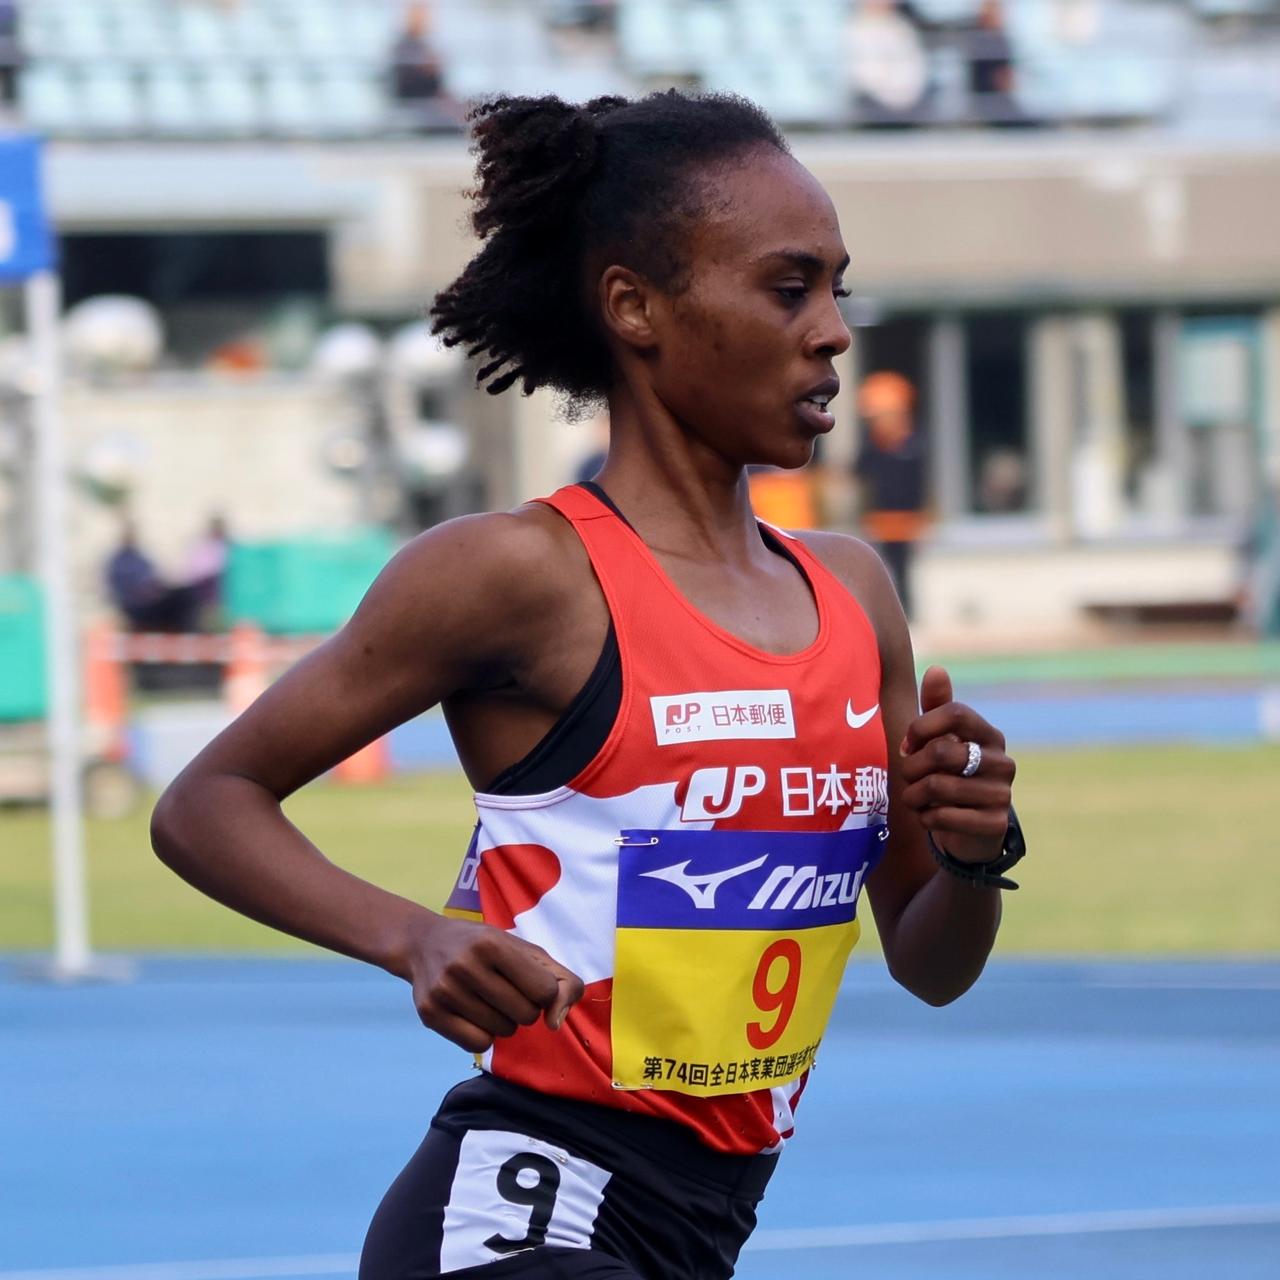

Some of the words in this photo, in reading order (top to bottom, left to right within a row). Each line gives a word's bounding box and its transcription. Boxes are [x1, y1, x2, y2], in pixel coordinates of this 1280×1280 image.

[665, 724, 702, 735] POST
[666, 702, 701, 727] JP
[712, 703, 786, 727] 日本郵便
[681, 765, 766, 821] JP
[780, 764, 888, 816] 日本郵
[746, 938, 802, 1050] 9
[483, 1152, 561, 1255] 9
